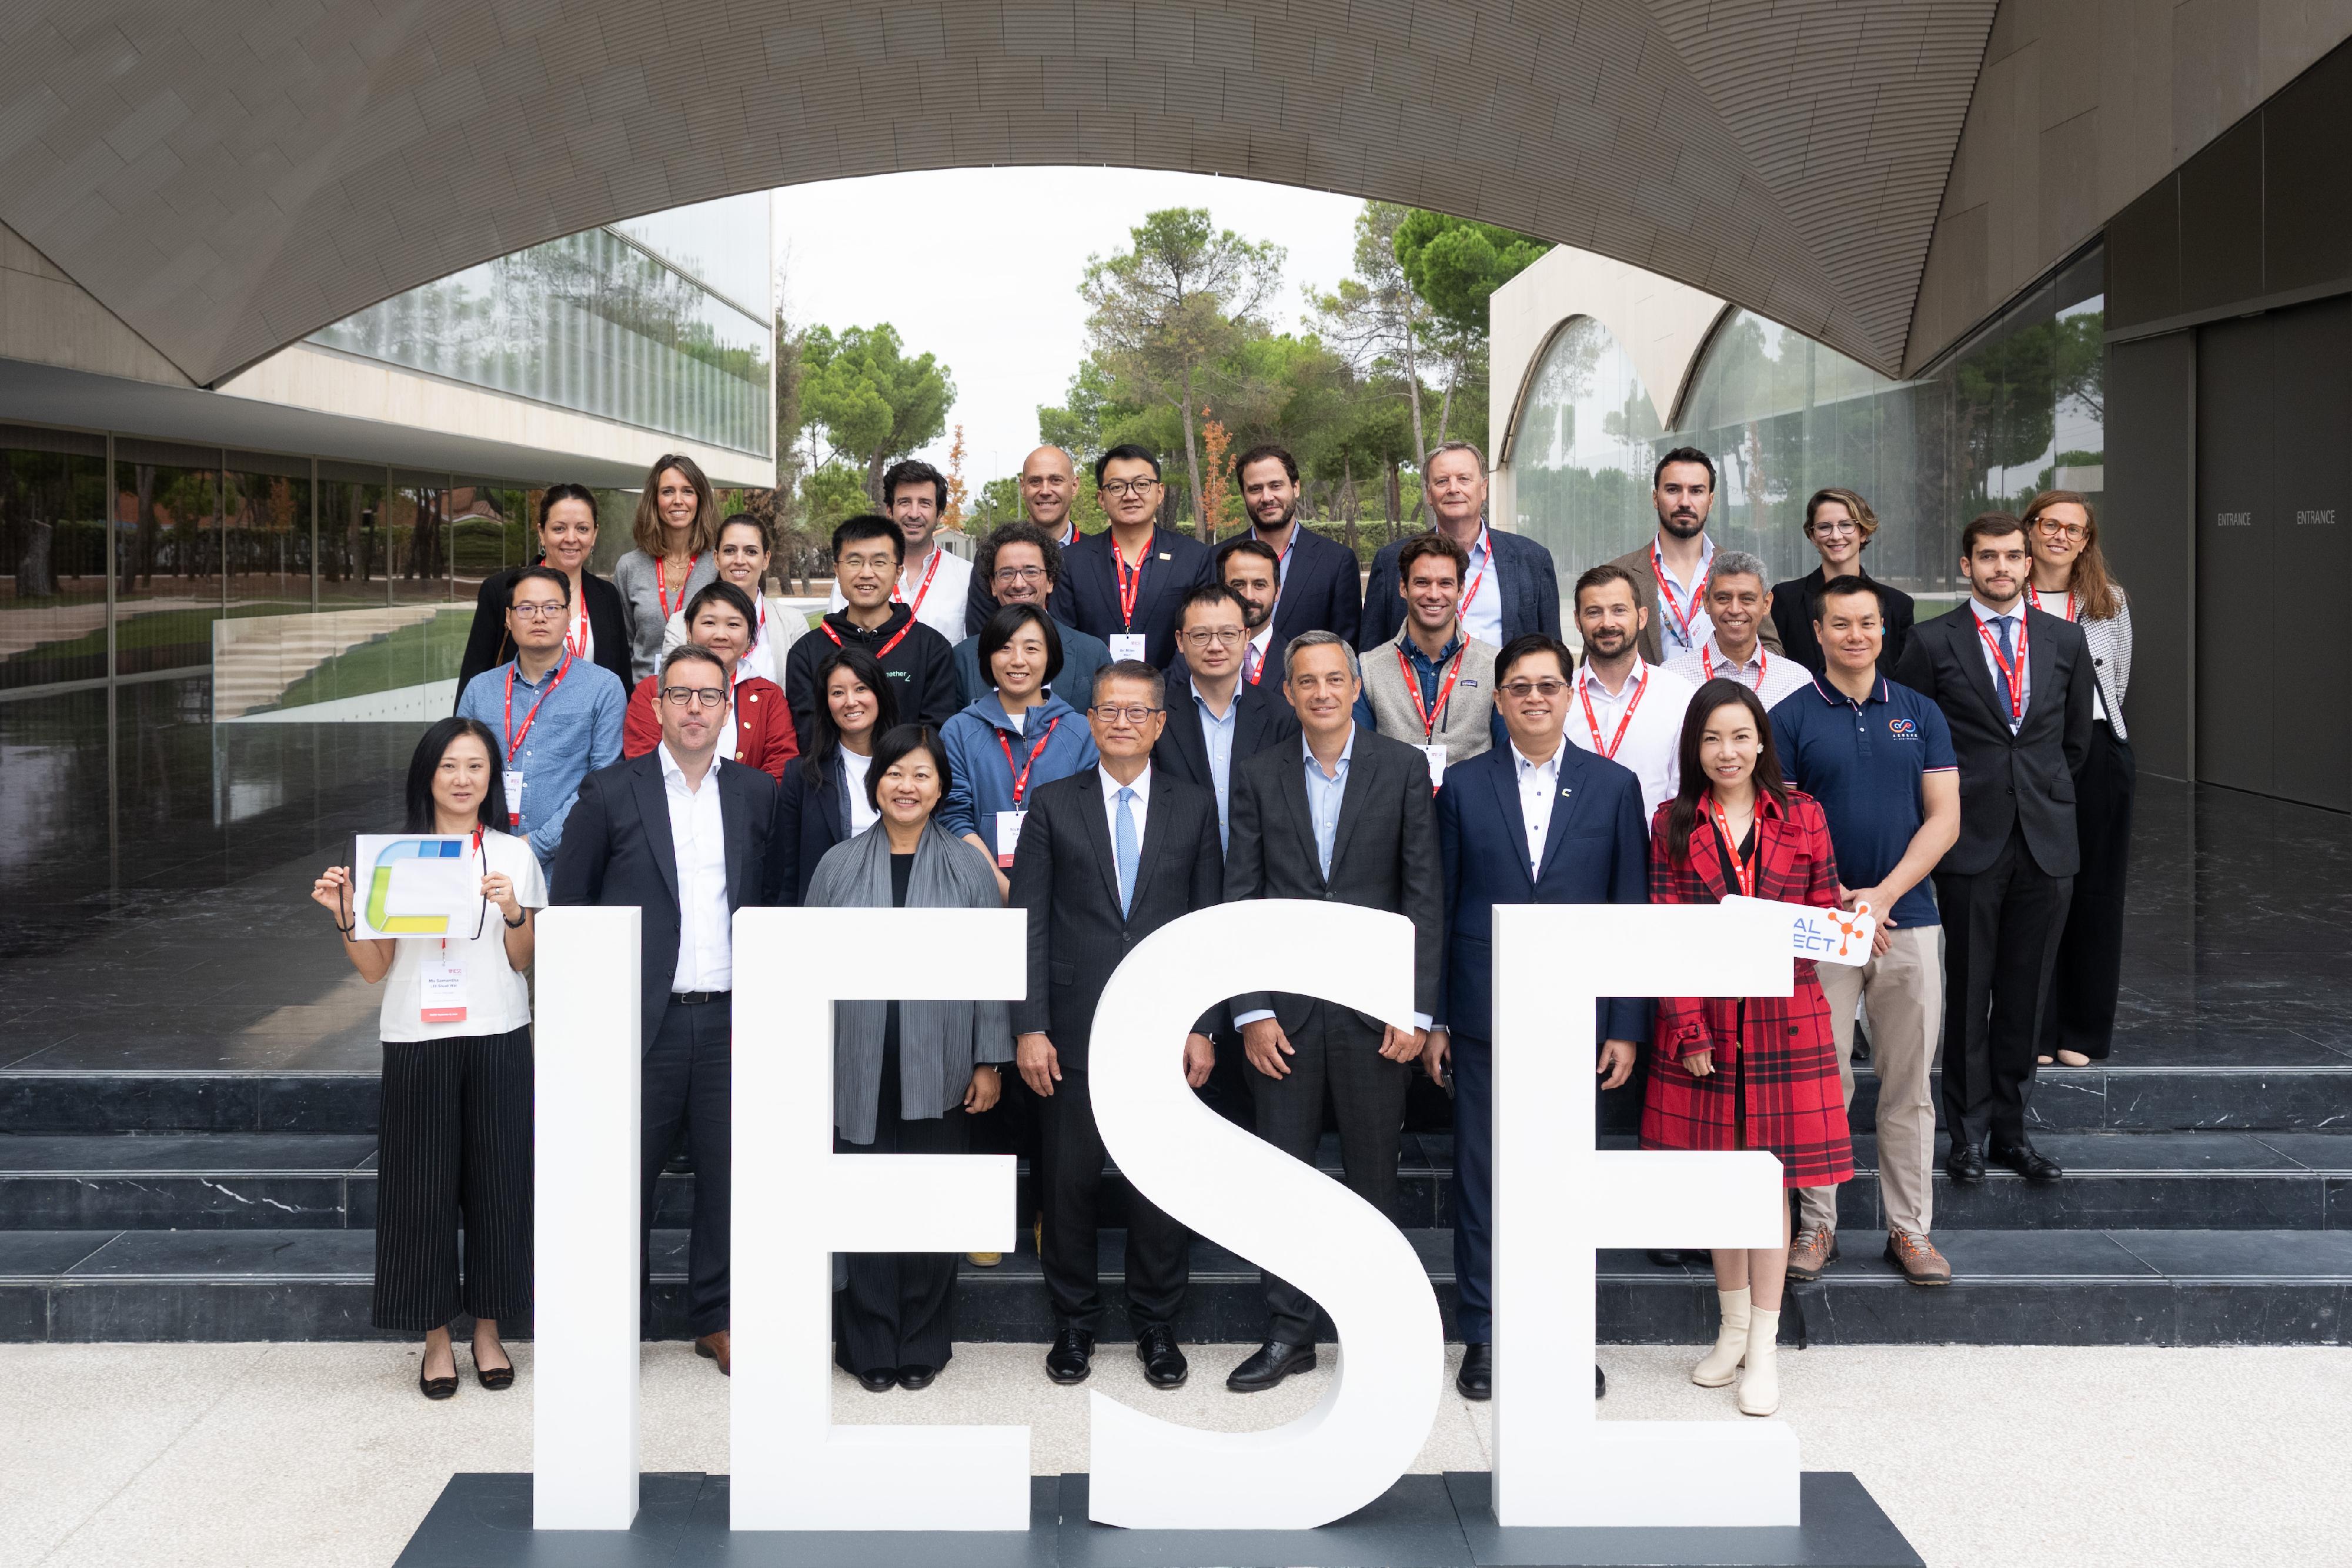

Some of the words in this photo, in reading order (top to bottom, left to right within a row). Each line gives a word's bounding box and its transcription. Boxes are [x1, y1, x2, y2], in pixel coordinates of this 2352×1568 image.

[2217, 512, 2251, 526] ENTRANCE
[2297, 510, 2335, 524] ENTRANCE
[533, 898, 1800, 1532] IESE
